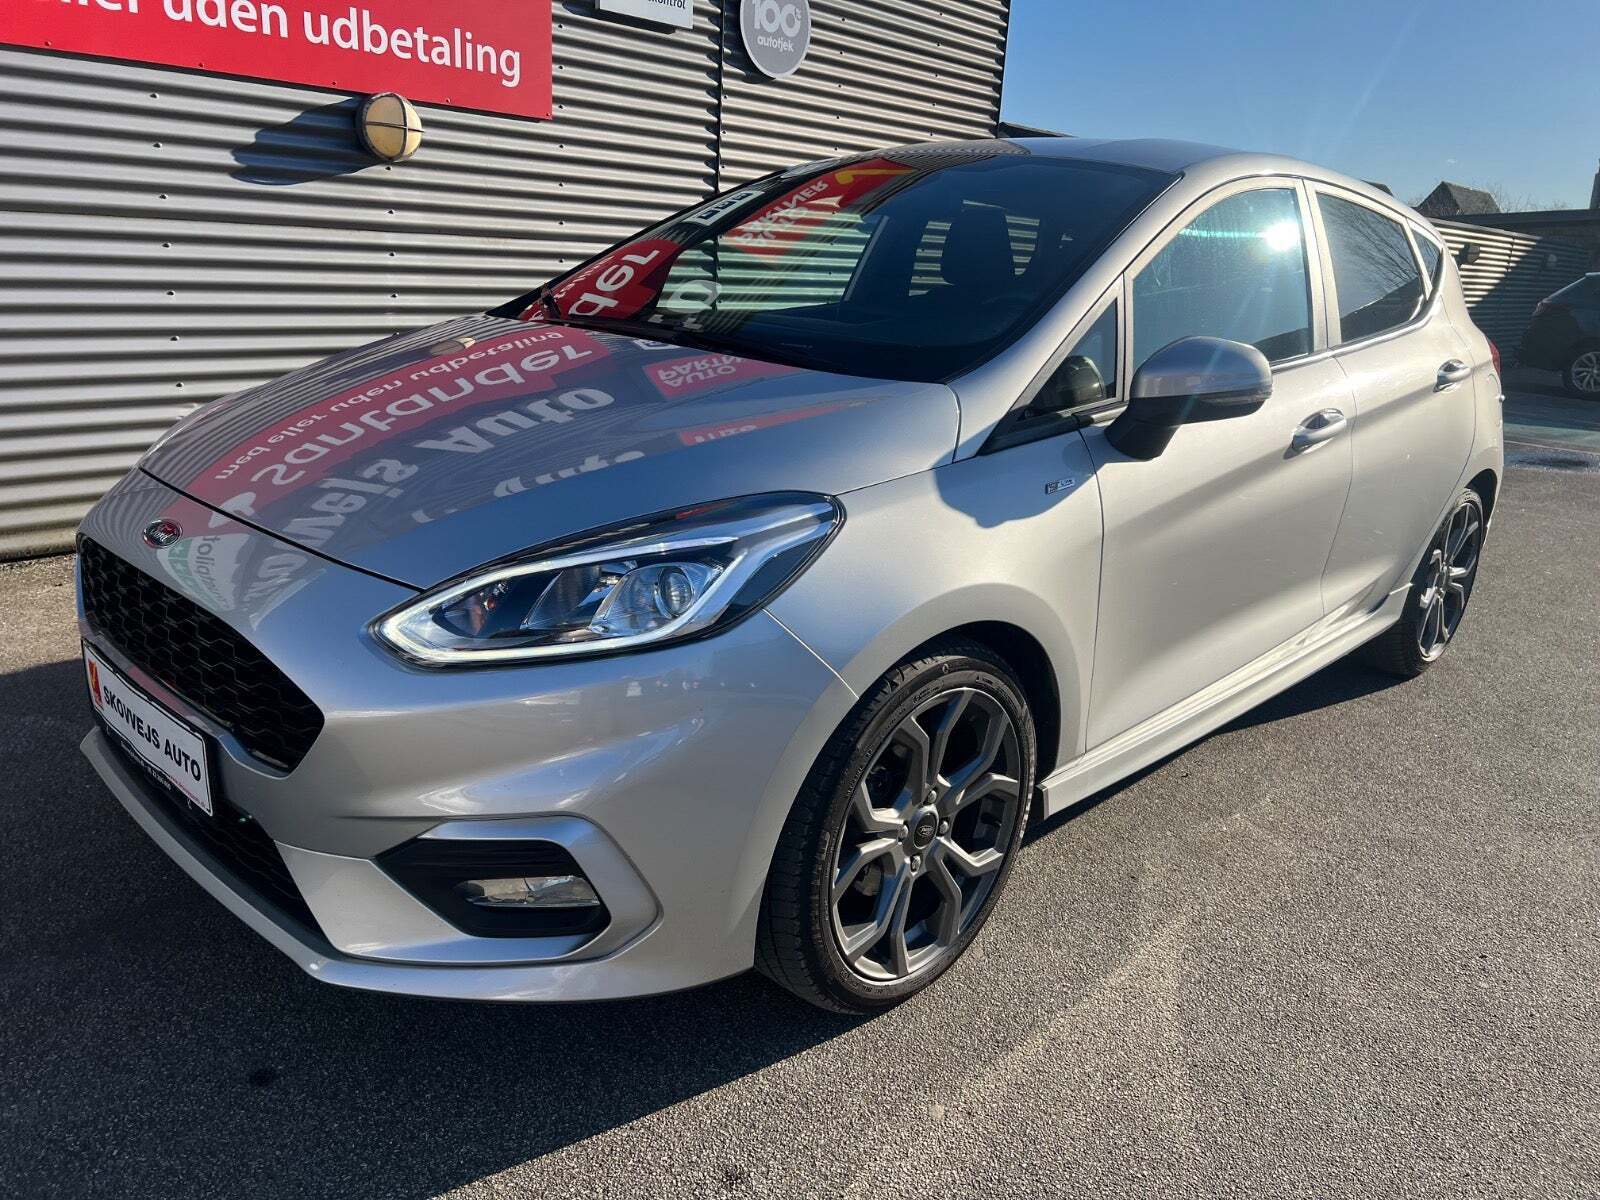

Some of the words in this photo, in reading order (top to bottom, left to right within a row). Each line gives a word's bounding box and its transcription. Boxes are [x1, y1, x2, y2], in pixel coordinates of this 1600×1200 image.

[163, 0, 289, 38] uden
[303, 9, 521, 87] udbetaling
[757, 36, 794, 52] autotjek
[103, 686, 160, 749] SKOVVEJS
[165, 739, 201, 781] AUTO
